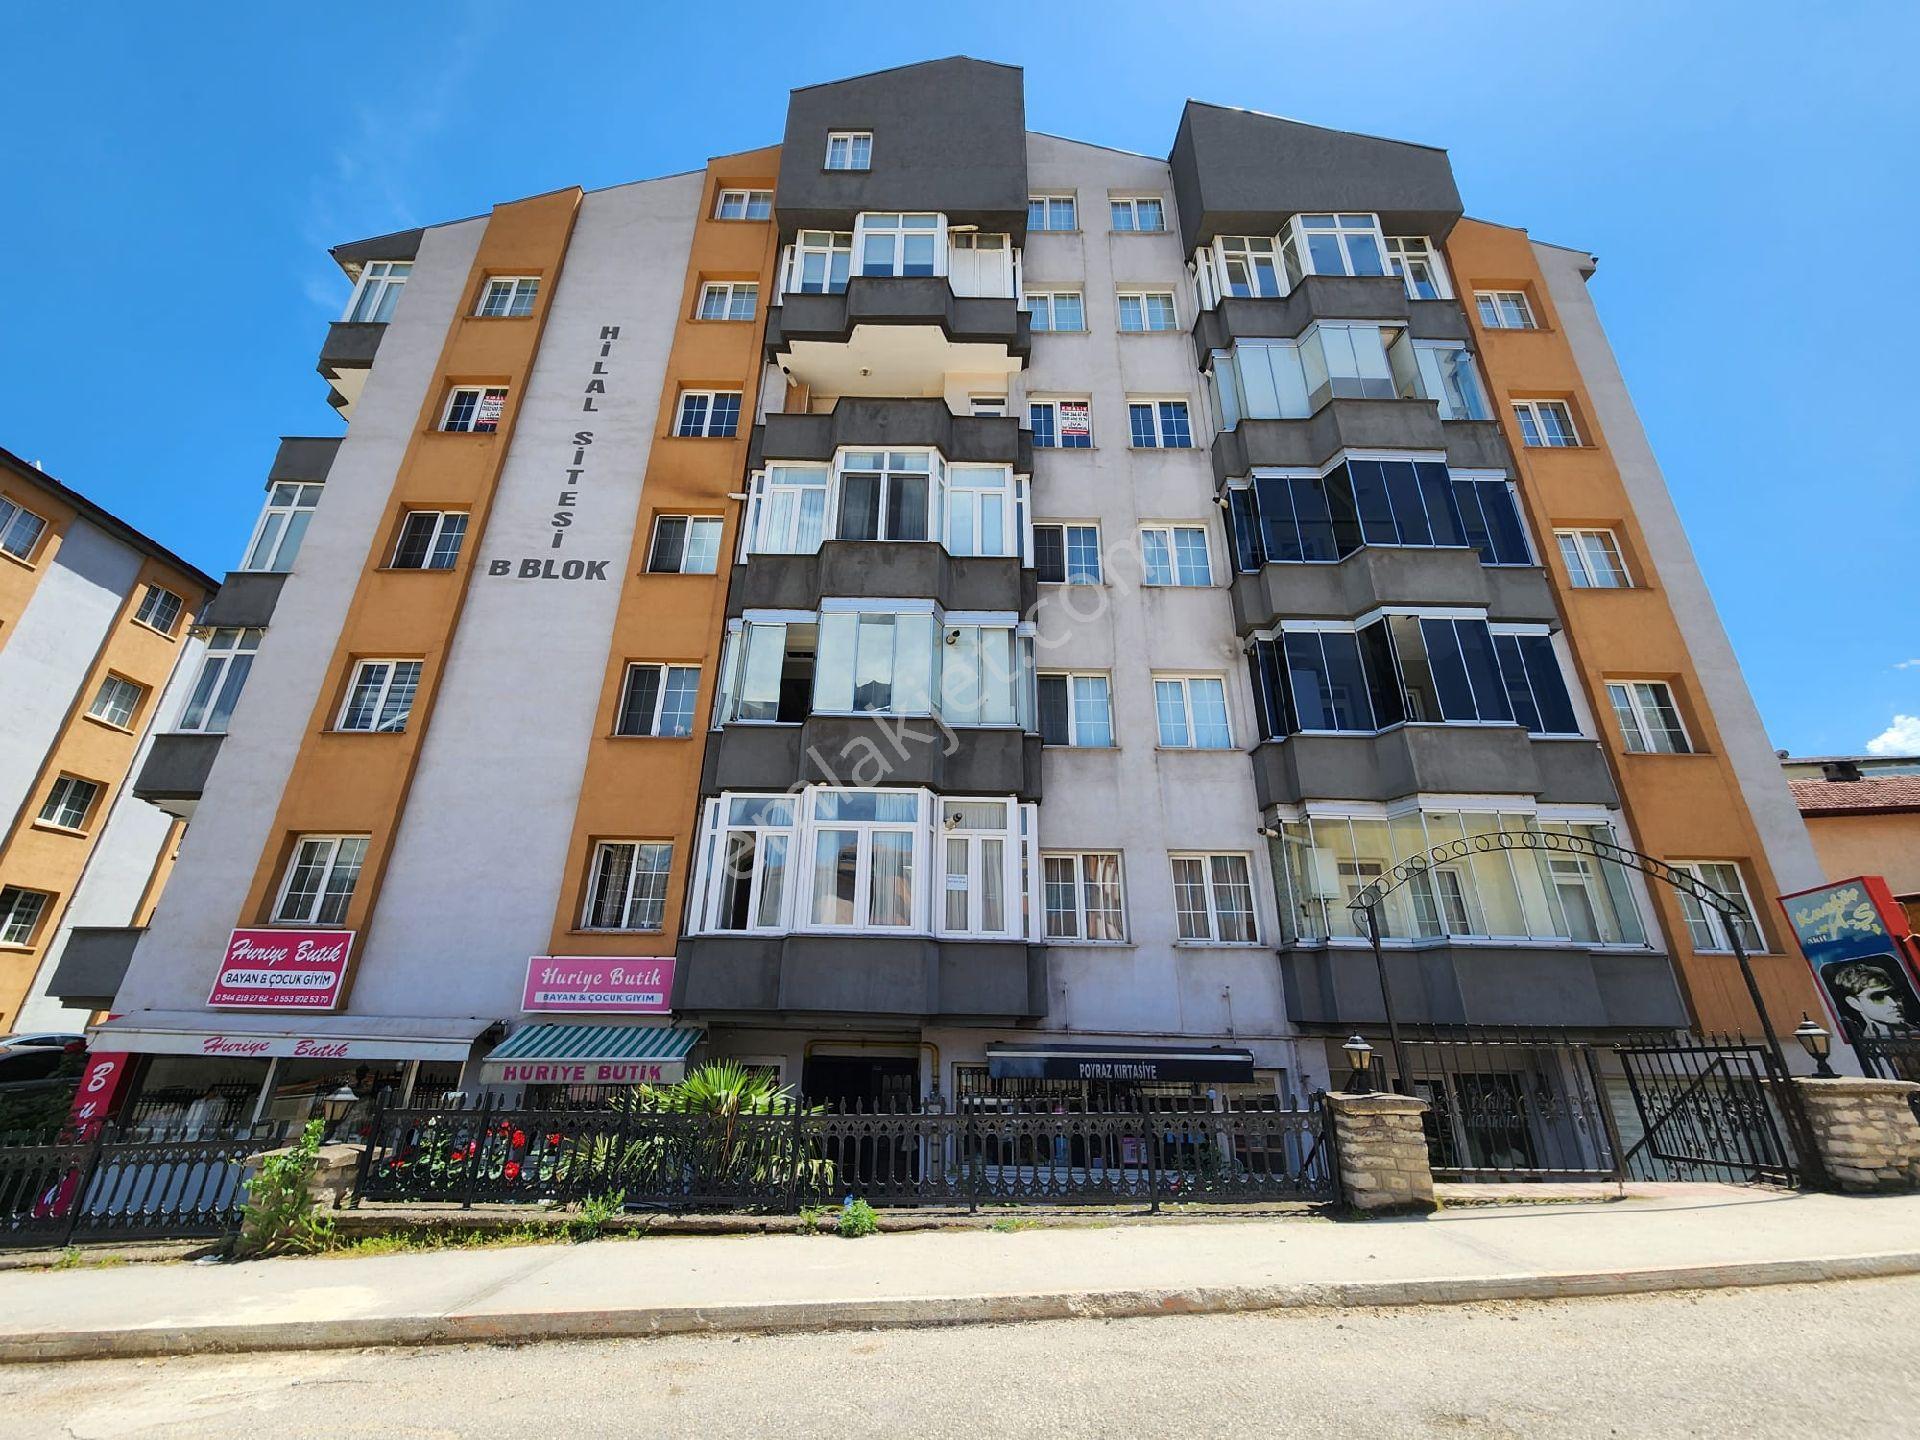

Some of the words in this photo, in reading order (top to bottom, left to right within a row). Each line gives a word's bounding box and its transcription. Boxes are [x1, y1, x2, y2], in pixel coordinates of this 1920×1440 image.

[582, 326, 620, 412] HİLAL
[551, 431, 594, 548] SİTESİ
[488, 560, 511, 576] B
[518, 559, 610, 580] BLOK
[231, 939, 288, 966] Huriye
[295, 940, 344, 963] Butik
[226, 973, 257, 983] BAYAN
[260, 974, 267, 983] &
[269, 974, 303, 987] ÇOCUK
[303, 972, 331, 985] GİYİM
[541, 967, 602, 991] Huriye
[610, 967, 661, 986] Butik
[543, 993, 576, 1001] BAYAN
[588, 994, 624, 1003] ÇOCUK
[204, 1036, 270, 1055] Huriye
[294, 1039, 350, 1057] Butik
[503, 1065, 586, 1081] HURİYE
[597, 1065, 663, 1081] BUTİK
[1079, 1063, 1112, 1079] POYRAZ
[1113, 1061, 1157, 1080] KIRTASİYE
